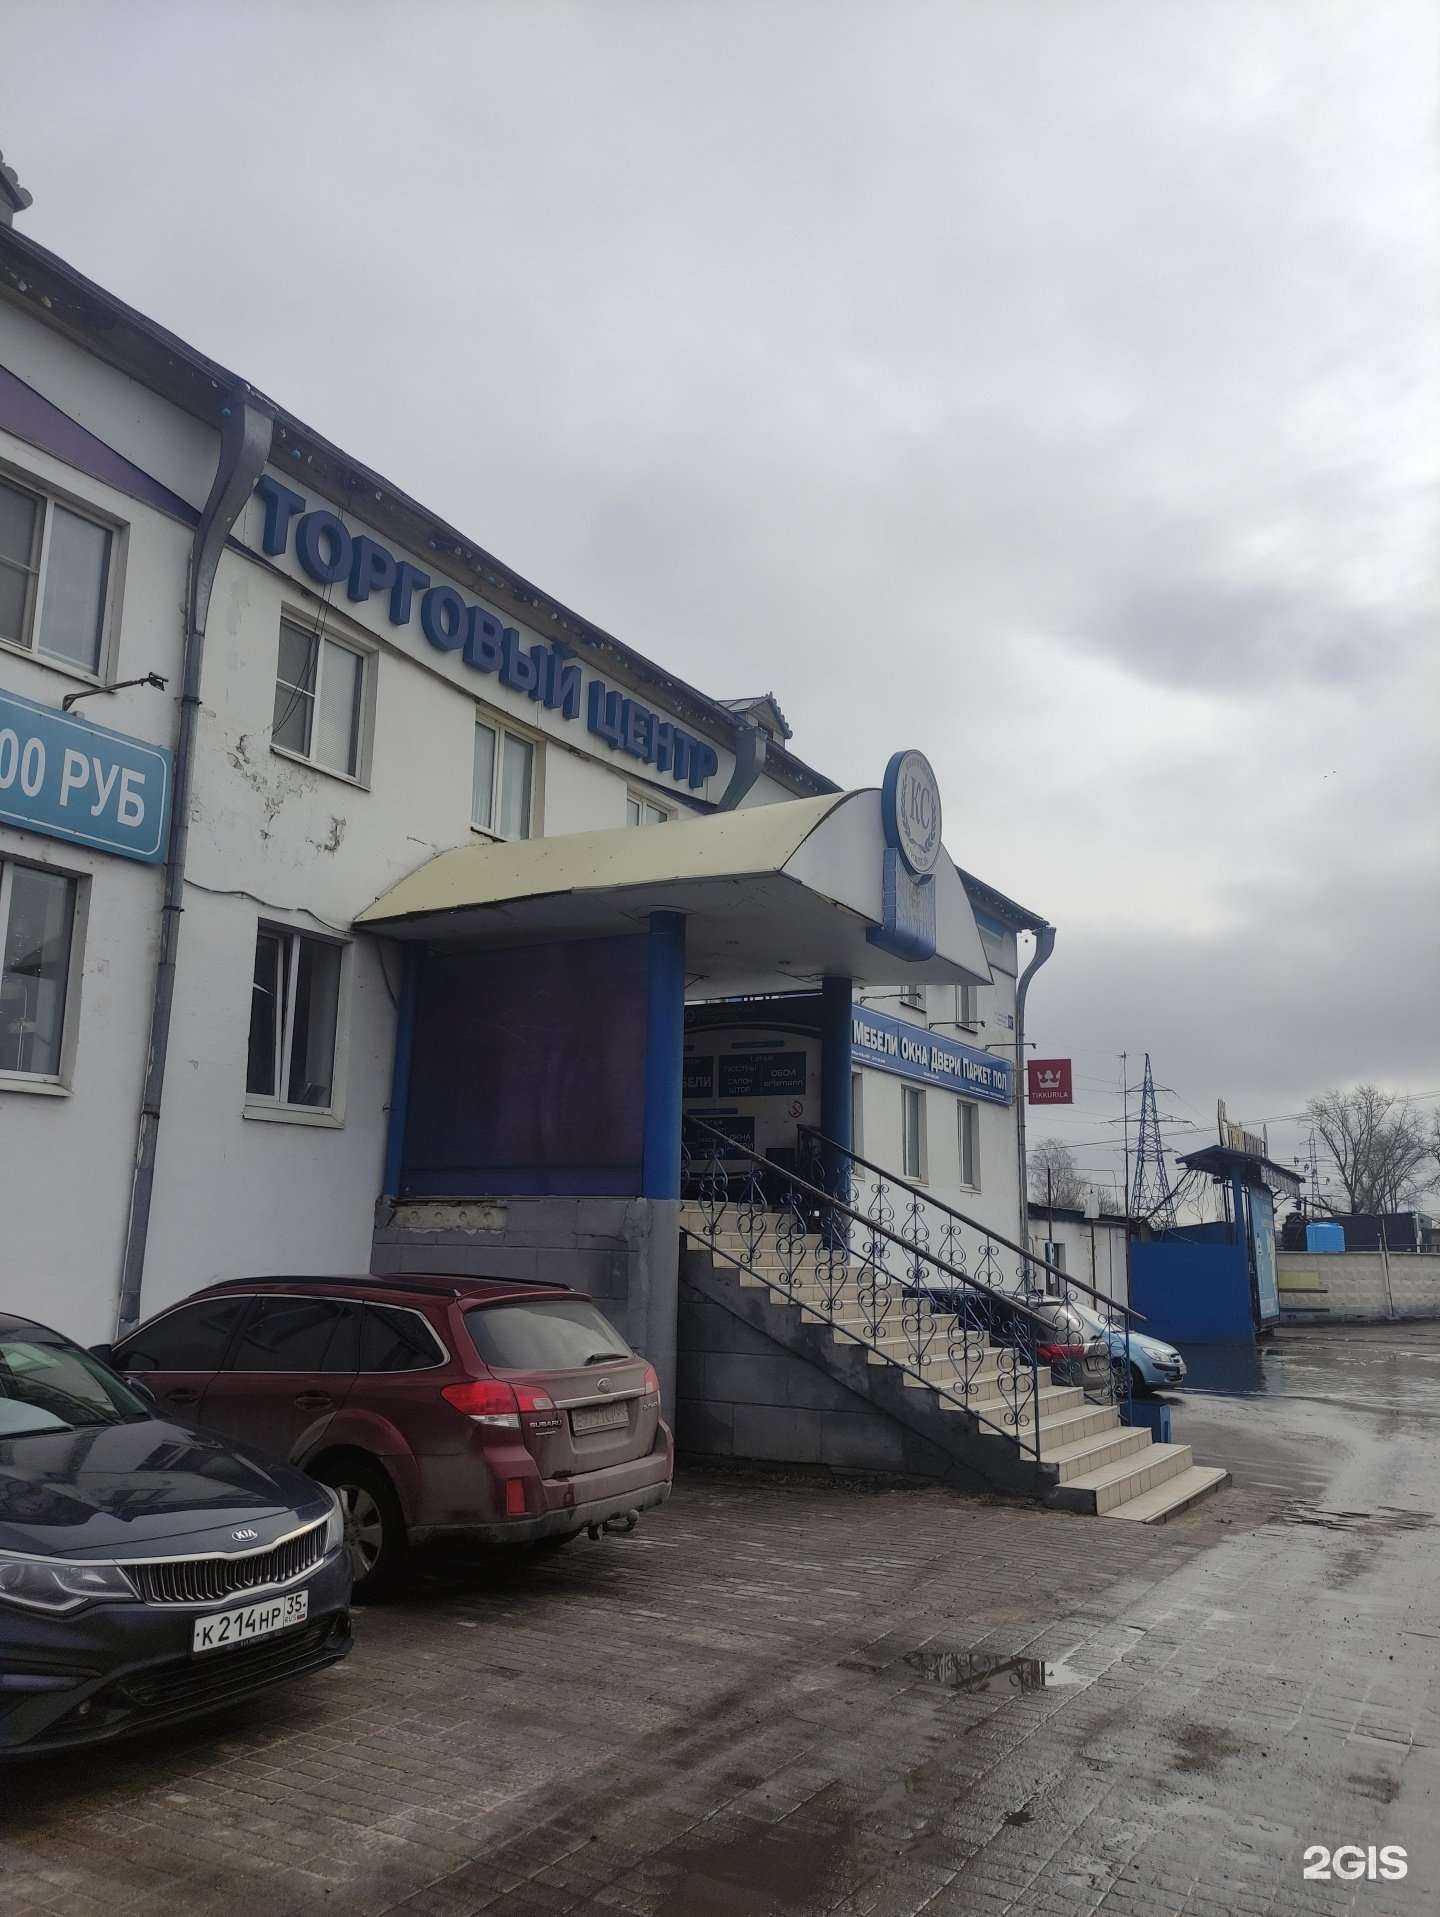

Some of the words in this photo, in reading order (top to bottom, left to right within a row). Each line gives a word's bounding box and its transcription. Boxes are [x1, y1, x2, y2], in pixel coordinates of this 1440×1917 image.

[254, 474, 582, 720] ТОРГОВЫЙ
[587, 680, 718, 789] ЦЕНТР
[59, 748, 146, 828] РУБ
[853, 1020, 898, 1057] МЕБЕЛИ
[901, 1036, 928, 1066] ОКНА
[930, 1046, 961, 1076] ДВЕРИ
[530, 1420, 561, 1428] SUBARU
[235, 1529, 256, 1539] KIA
[202, 1608, 281, 1646] К214НР
[286, 1594, 303, 1615] 35
